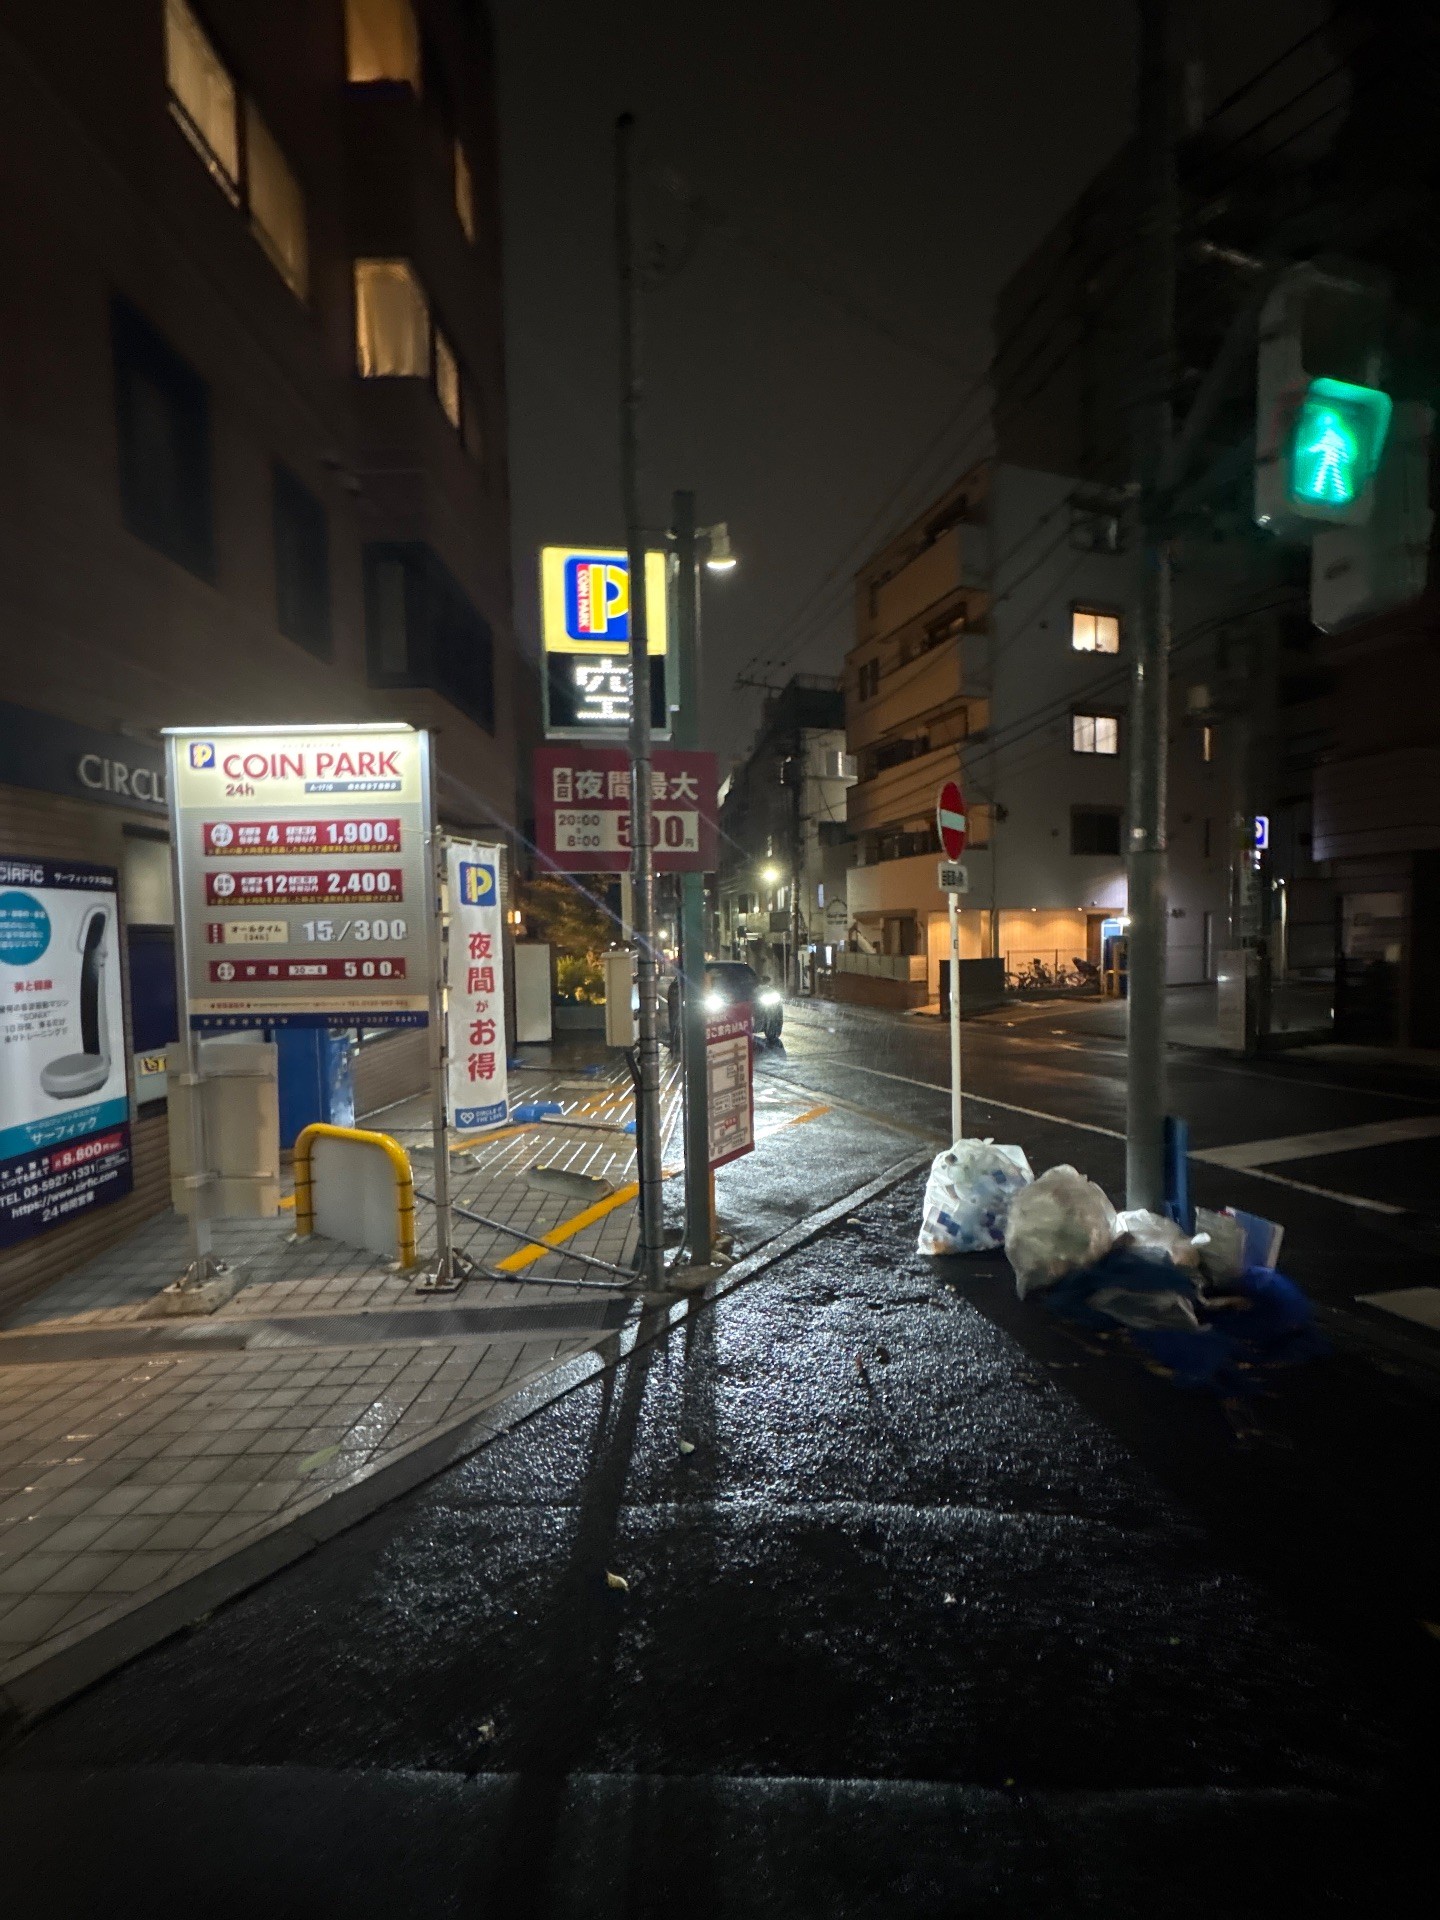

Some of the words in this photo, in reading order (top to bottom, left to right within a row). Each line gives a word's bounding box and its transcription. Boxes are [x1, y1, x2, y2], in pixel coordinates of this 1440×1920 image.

[575, 658, 634, 719] 空
[222, 752, 304, 779] COIN
[315, 749, 401, 778] PARK
[225, 782, 254, 797] 24h
[574, 770, 700, 801] 夜間最大
[558, 814, 601, 826] 20:00
[266, 825, 279, 844] 4
[567, 835, 601, 847] 8:00
[263, 875, 288, 894] 12
[232, 925, 281, 933] オールタイム
[466, 932, 496, 1082] 夜間がお得
[31, 1116, 97, 1145] サーフィック
[0, 1193, 21, 1208] TEL
[23, 1164, 96, 1199] 03-5927-1331
